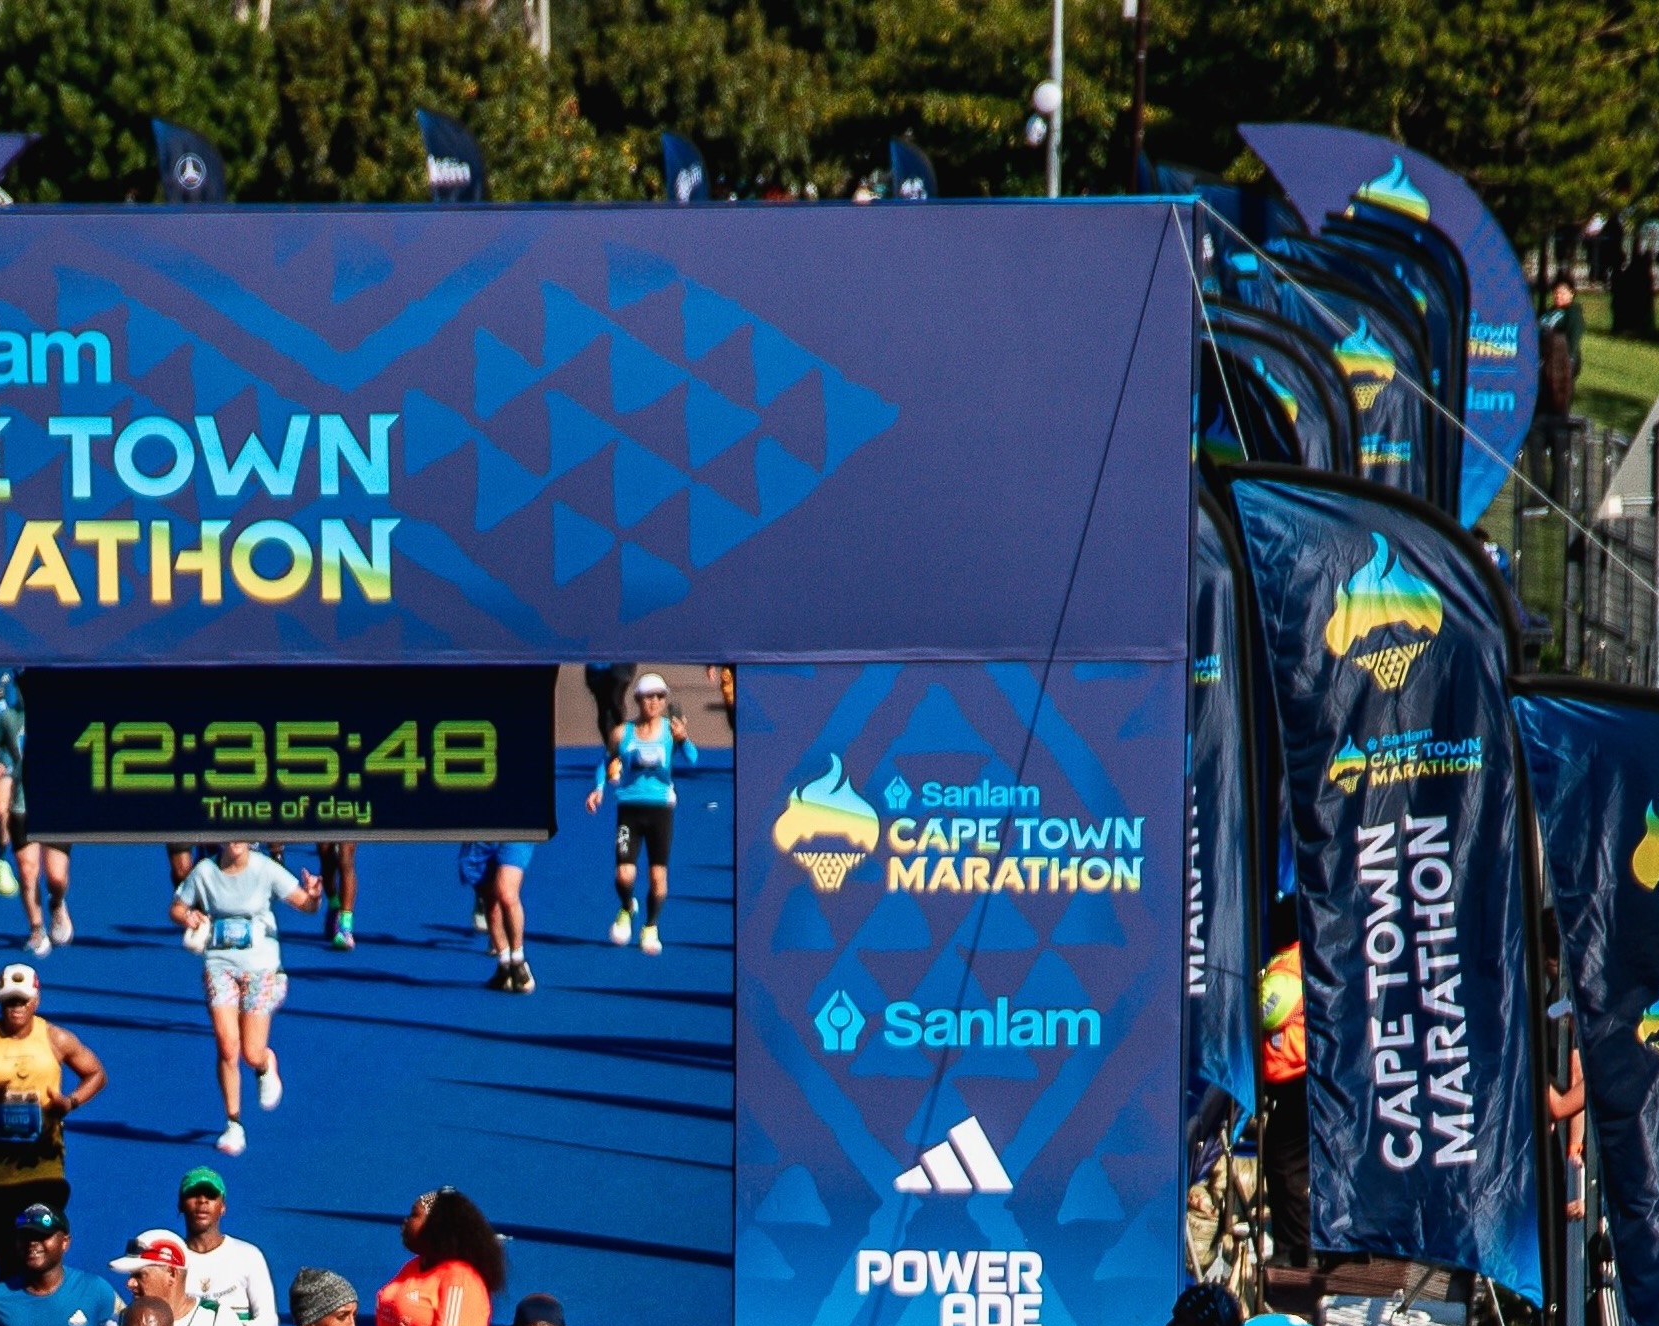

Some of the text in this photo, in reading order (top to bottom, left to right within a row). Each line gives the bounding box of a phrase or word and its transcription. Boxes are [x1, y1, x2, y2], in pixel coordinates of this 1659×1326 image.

[50, 413, 400, 497] TOWN
[74, 719, 498, 791] 12:35:48
[1370, 737, 1481, 769] CAPE TOWN
[1381, 728, 1433, 747] Sanlam
[1370, 754, 1482, 787] MARATHON
[202, 796, 372, 824] Time of day
[921, 780, 1040, 807] Sanlam
[889, 815, 1145, 852] CAPE TOWN
[889, 856, 1143, 893] MARATHON
[1356, 820, 1424, 1170] CAPE TOWN
[1404, 813, 1478, 1167] MARATHON
[884, 995, 1100, 1046] Sanlam
[857, 1250, 1043, 1294] POWER
